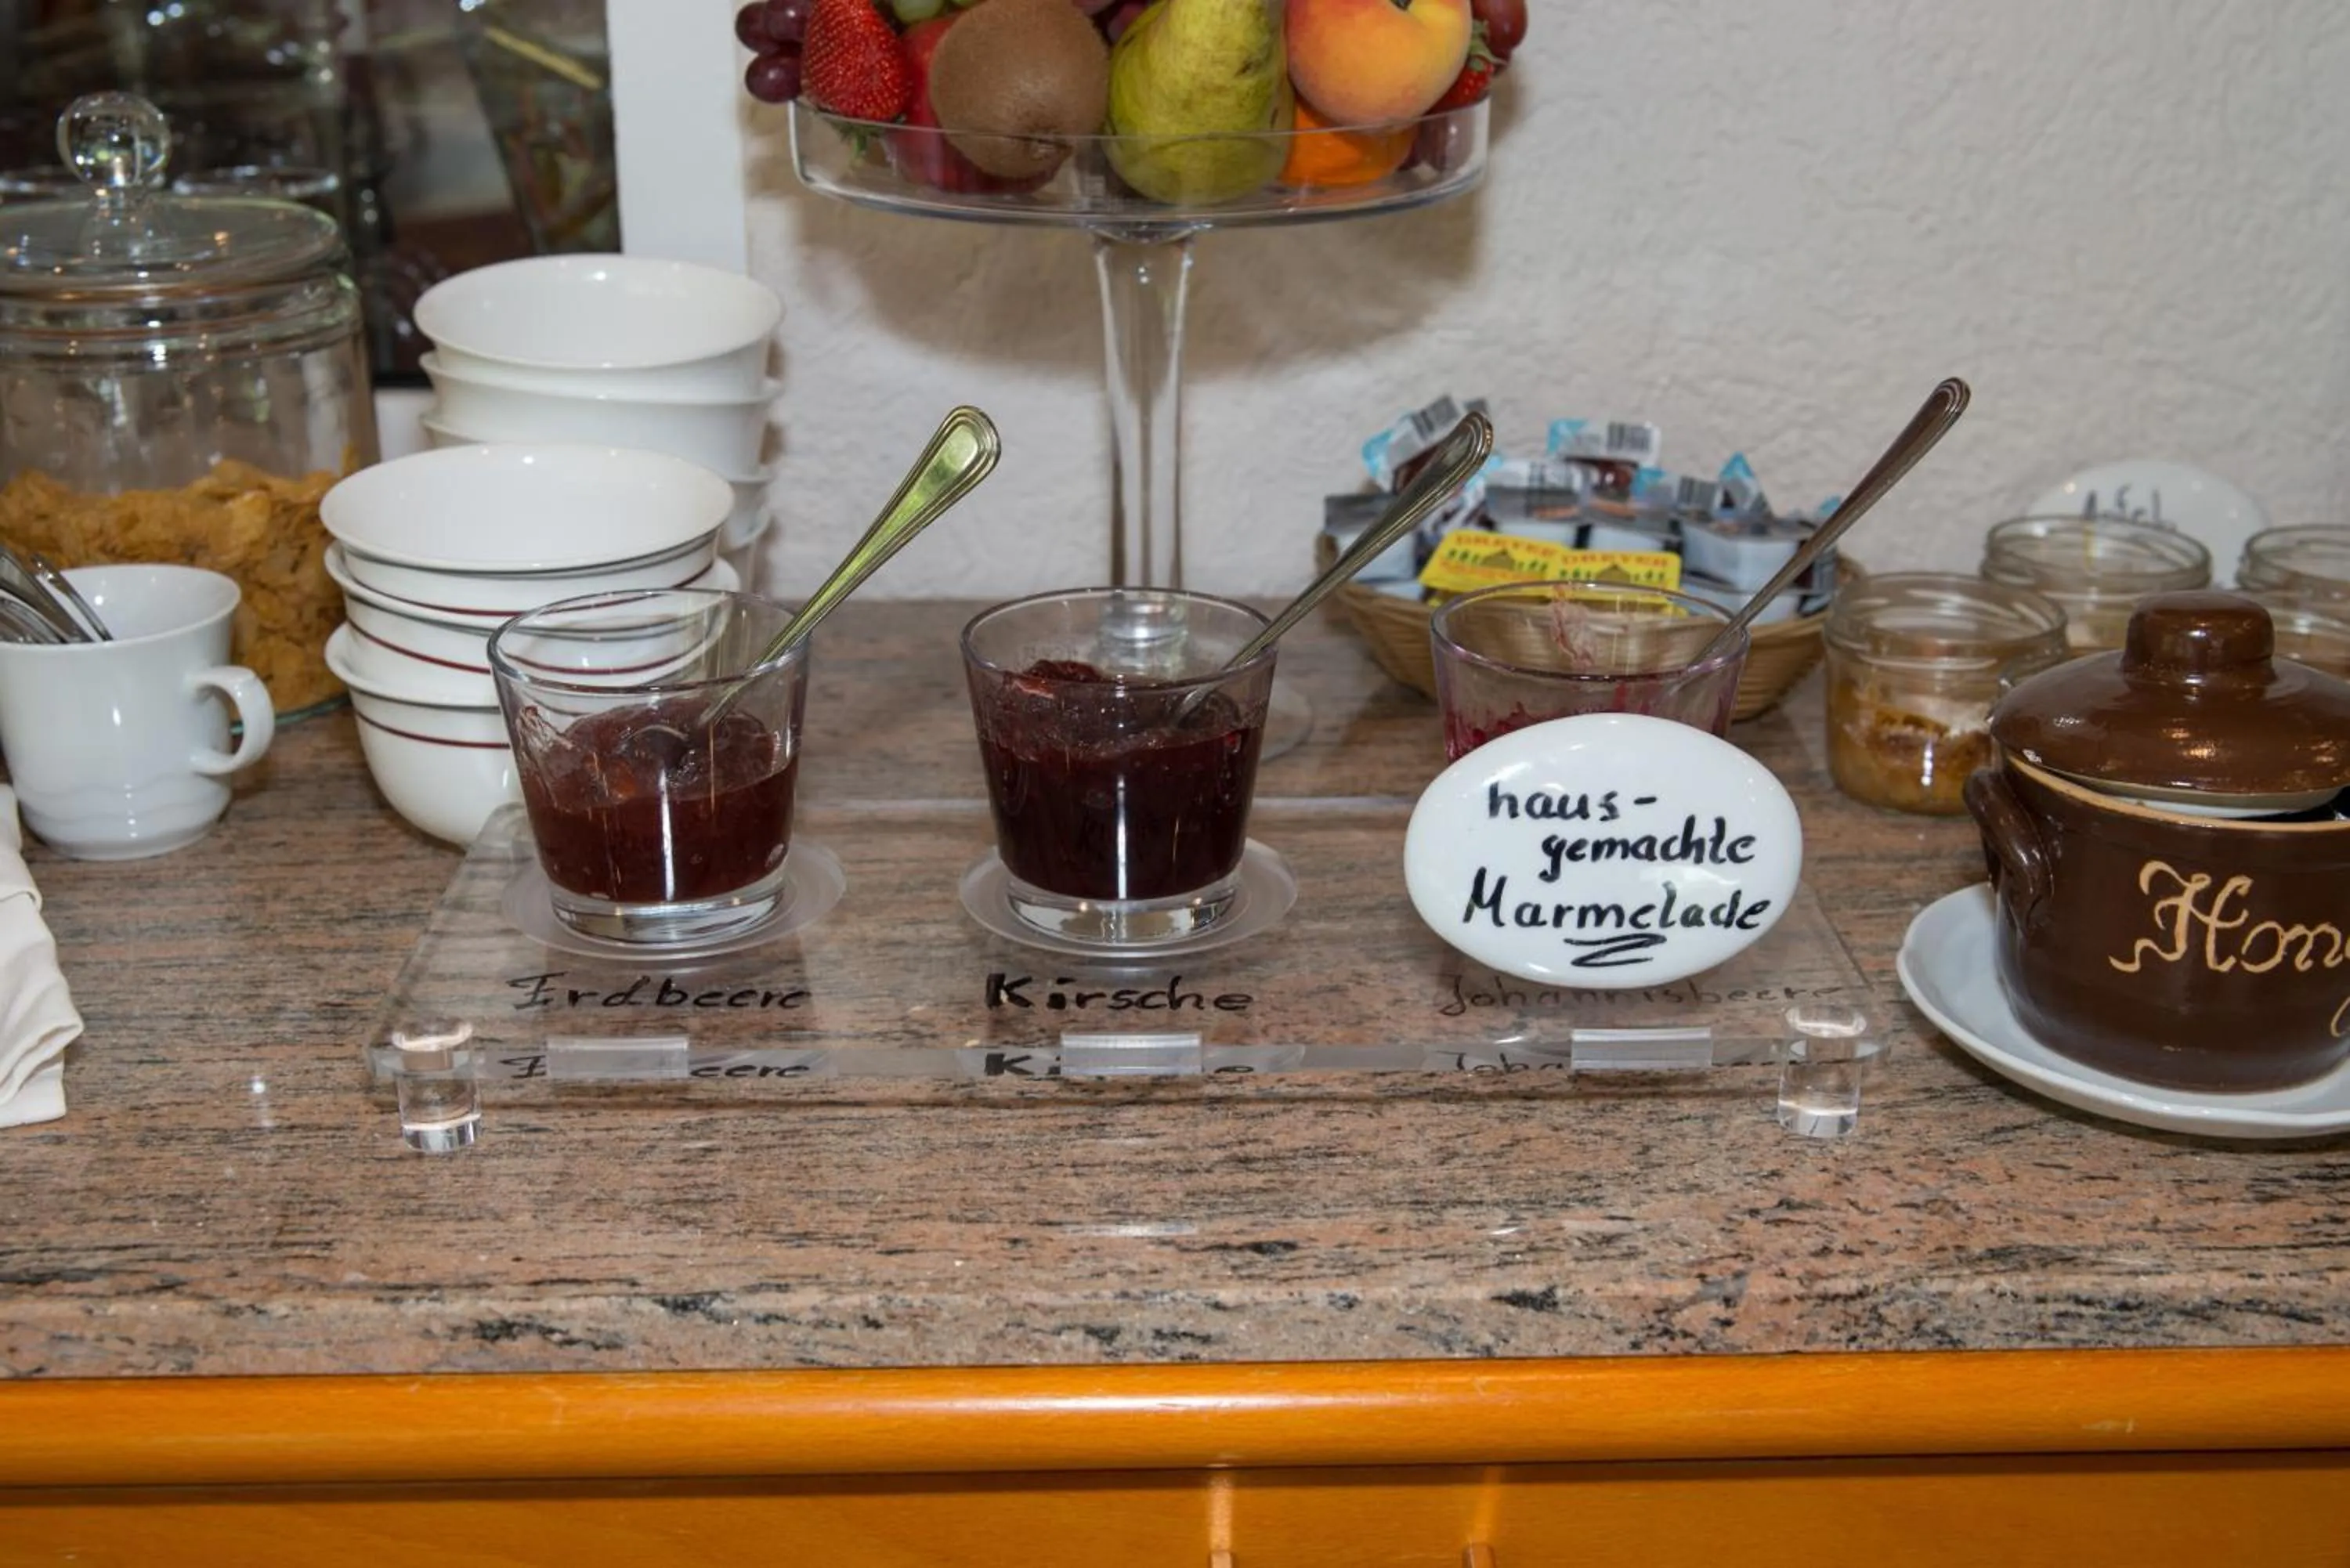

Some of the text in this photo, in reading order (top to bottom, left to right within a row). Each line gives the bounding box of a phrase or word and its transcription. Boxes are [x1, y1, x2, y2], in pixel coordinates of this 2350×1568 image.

[1488, 781, 1657, 822] haus-
[1538, 815, 1756, 882] gemachte
[1462, 866, 1771, 930] Marmelade
[2108, 860, 2350, 1037] Hon
[506, 971, 812, 1010] Erdbeere
[985, 972, 1254, 1011] Kirsche
